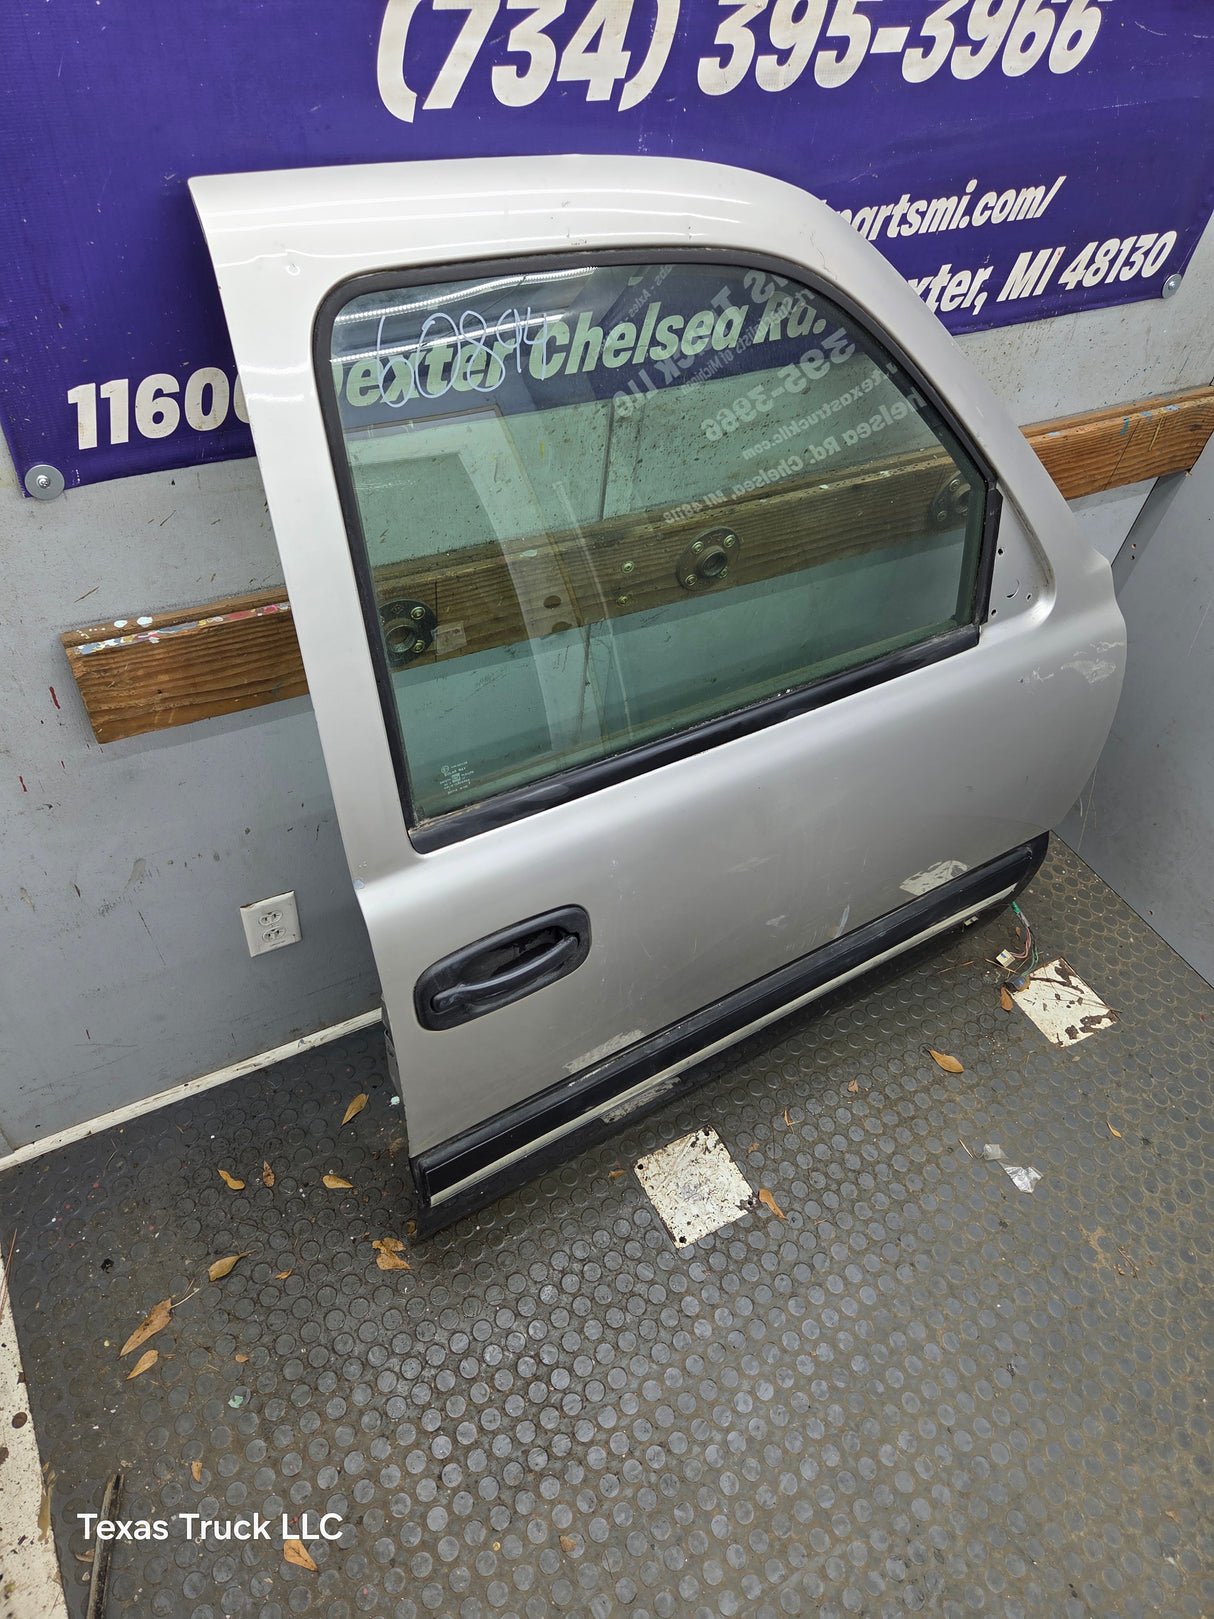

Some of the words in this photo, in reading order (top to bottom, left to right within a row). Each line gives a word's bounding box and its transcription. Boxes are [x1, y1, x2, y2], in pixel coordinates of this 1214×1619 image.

[377, 0, 680, 123] (734)
[697, 0, 1103, 96] 395-3966
[829, 176, 1067, 241] artsmi.com/
[529, 301, 749, 381] Chelsea
[996, 246, 1066, 302] MI
[1058, 231, 1177, 291] 48130
